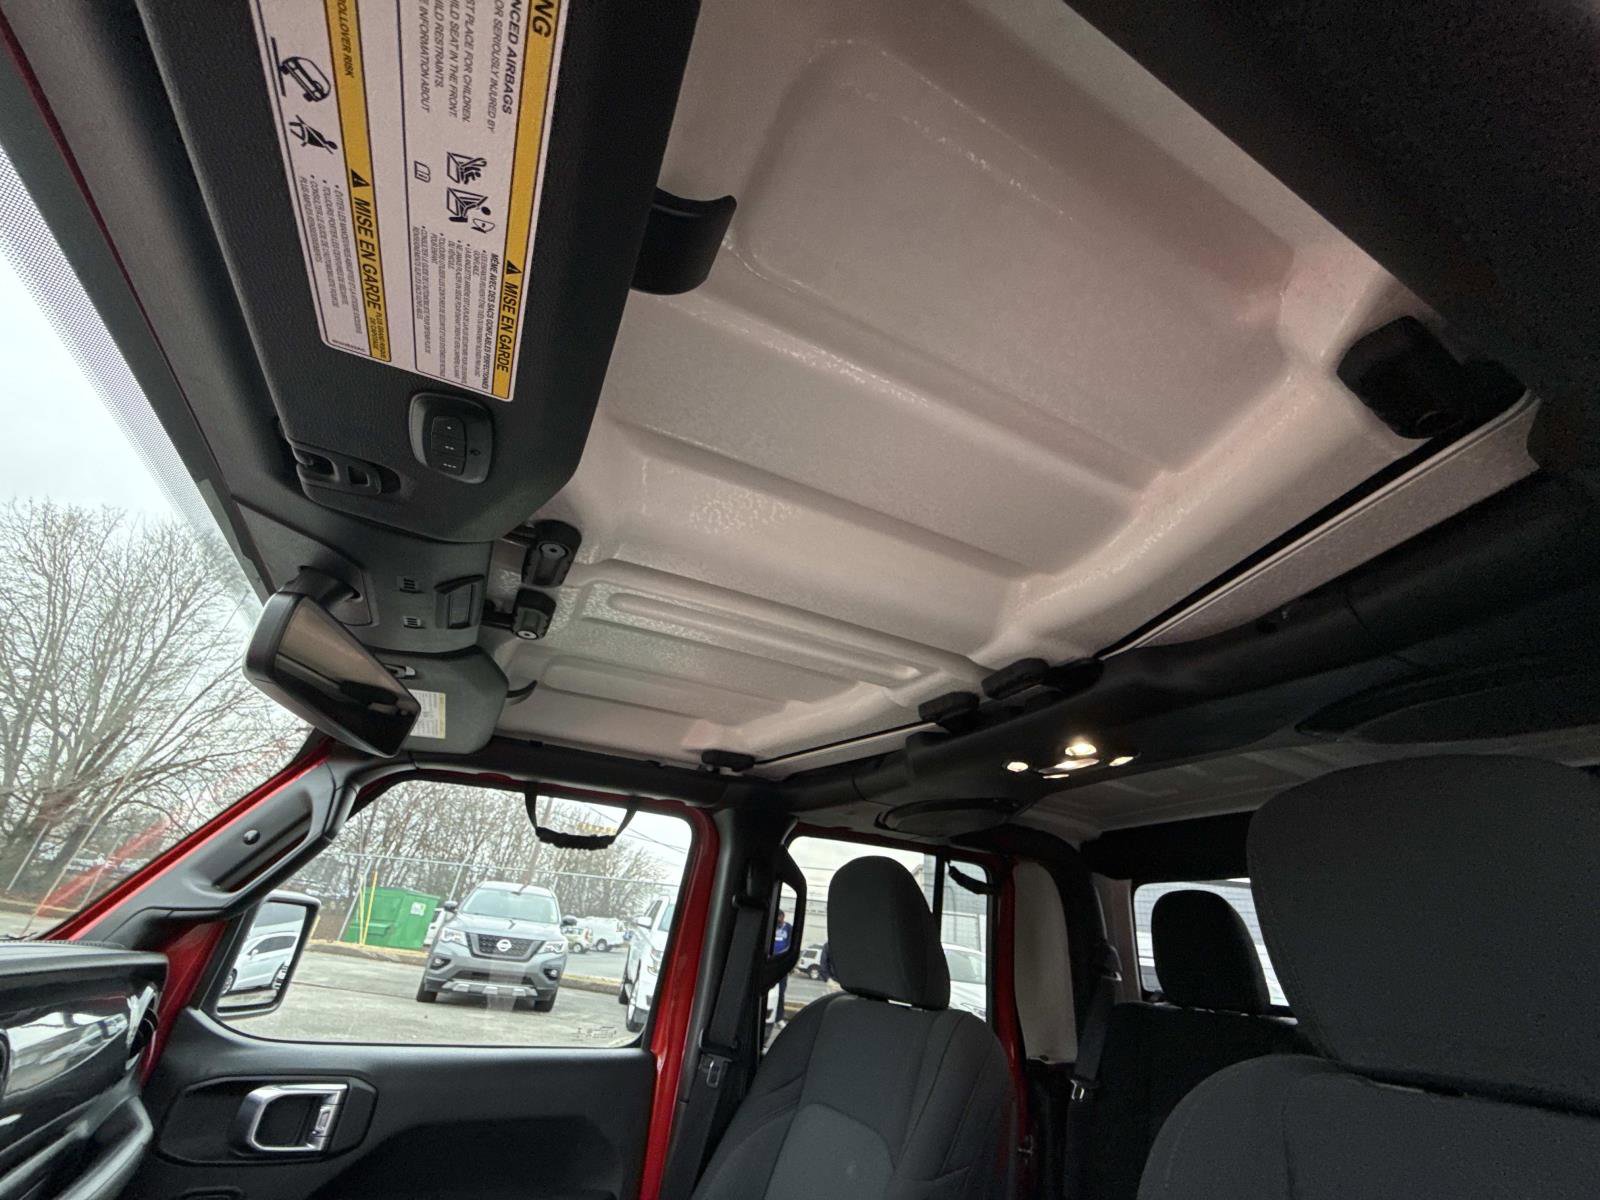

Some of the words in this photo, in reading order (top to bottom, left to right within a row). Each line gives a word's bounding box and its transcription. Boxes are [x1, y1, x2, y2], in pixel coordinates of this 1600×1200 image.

[494, 0, 504, 17] OR
[419, 7, 429, 78] INFORMATION
[449, 21, 459, 50] SEAT
[464, 13, 474, 49] PLACE
[449, 50, 458, 62] IN
[464, 50, 473, 73] FOR
[491, 19, 503, 77] SERIOUSLY
[449, 64, 459, 84] THE
[503, 47, 516, 114] AIRBAGS
[421, 79, 430, 112] ABOUT
[488, 78, 498, 118] INJURED
[487, 119, 495, 133] BY
[355, 198, 373, 238] MISE
[359, 239, 376, 262] EN
[363, 264, 381, 310] GARDE
[488, 290, 496, 303] DES
[503, 282, 518, 314] MISE
[487, 303, 495, 319] SACS
[501, 315, 514, 333] EN
[497, 335, 512, 372] GARDE
